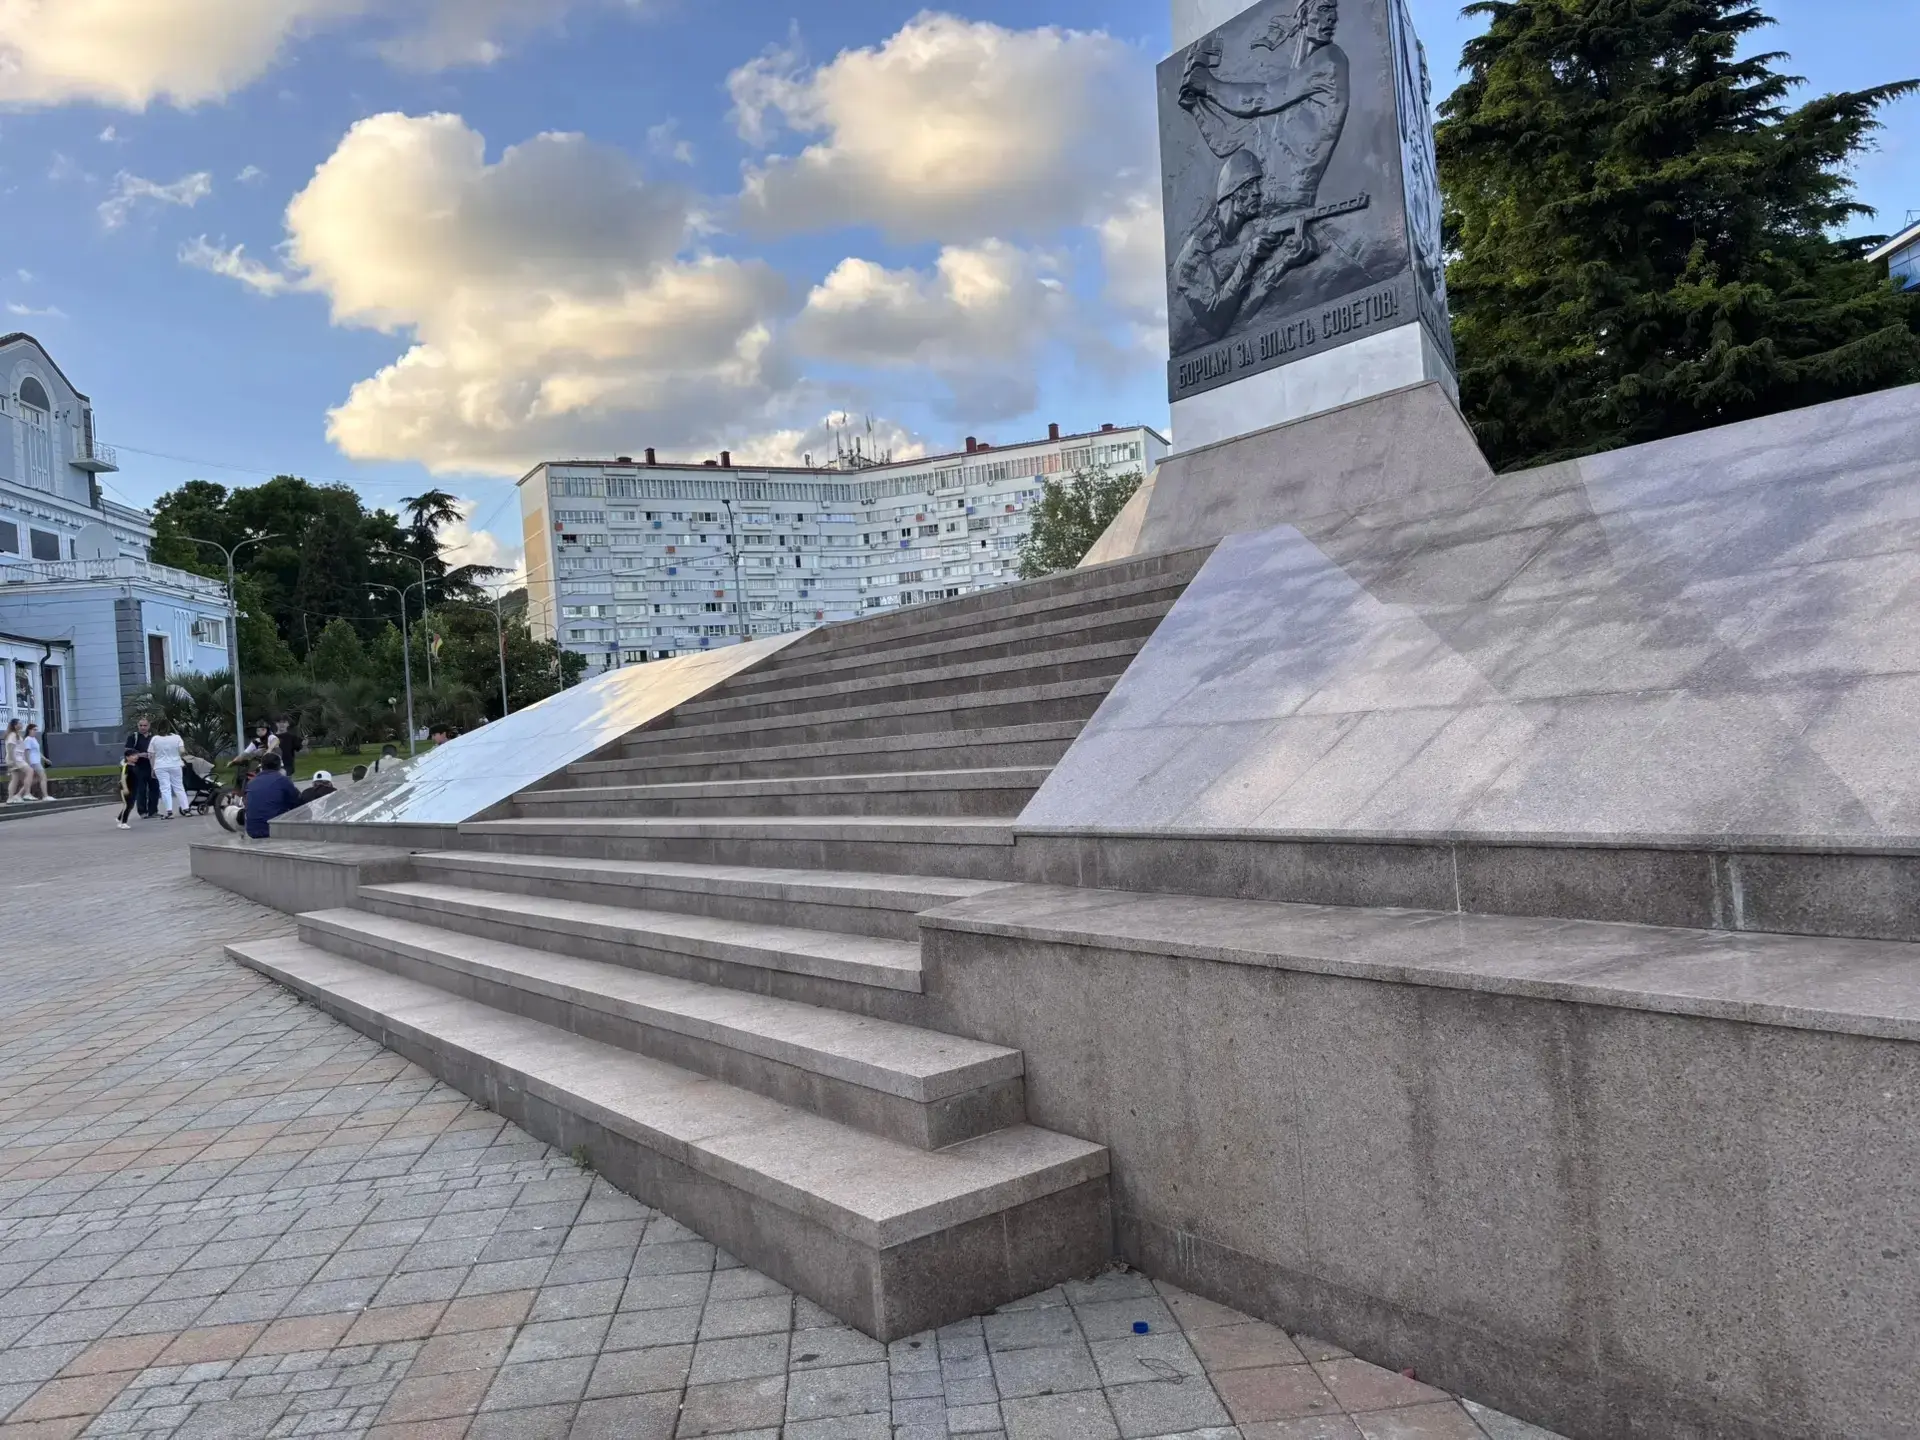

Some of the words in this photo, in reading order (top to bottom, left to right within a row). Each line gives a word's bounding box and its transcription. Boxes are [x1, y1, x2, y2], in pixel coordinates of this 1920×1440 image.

[1179, 346, 1232, 389] БОРЦАМ
[1236, 337, 1255, 369] ЗА
[1259, 318, 1316, 361] ВЛАСТЬ
[1322, 284, 1399, 339] СОВЕТОВ!
